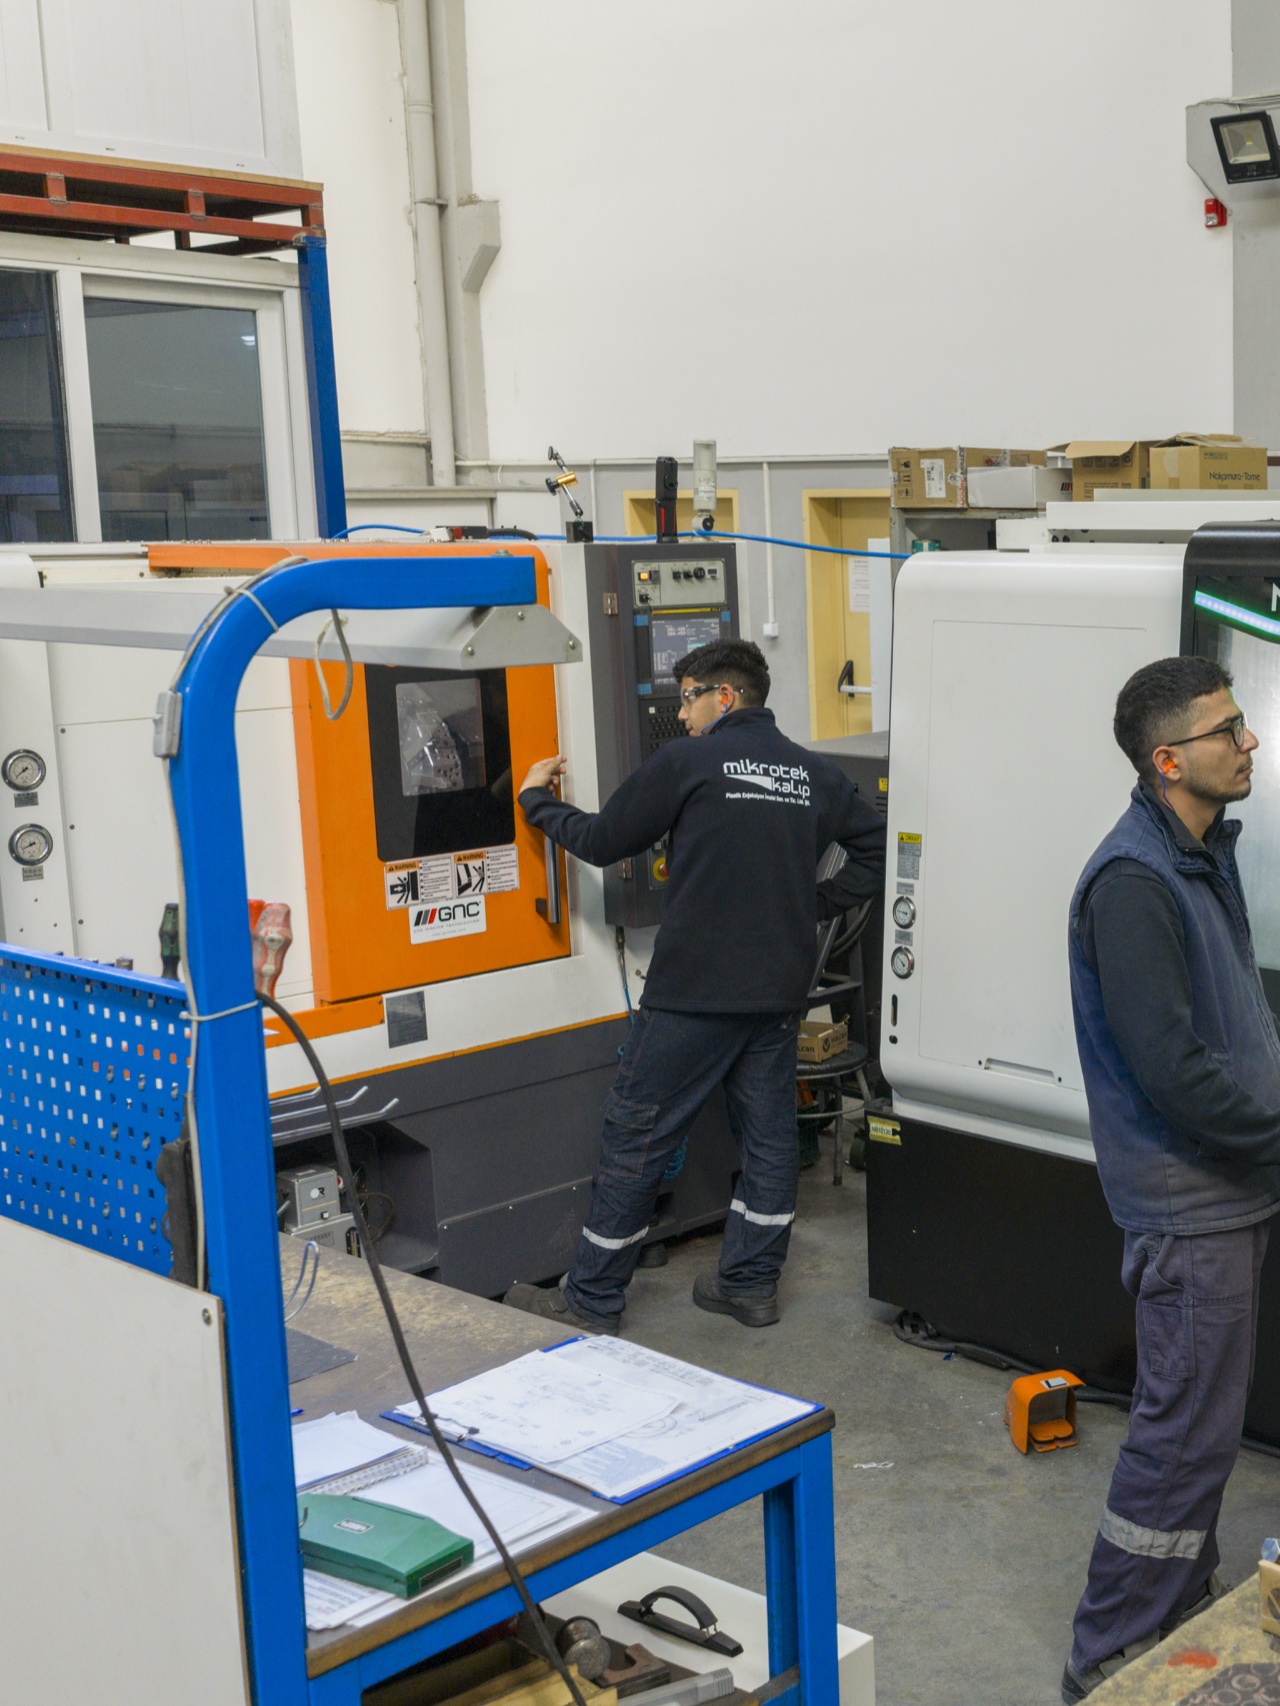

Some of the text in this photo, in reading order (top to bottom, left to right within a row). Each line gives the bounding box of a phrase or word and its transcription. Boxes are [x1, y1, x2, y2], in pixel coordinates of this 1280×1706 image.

[723, 758, 810, 782] mikrotek
[462, 852, 484, 861] WARNING
[395, 863, 416, 871] WARNING
[438, 901, 480, 922] GNC
